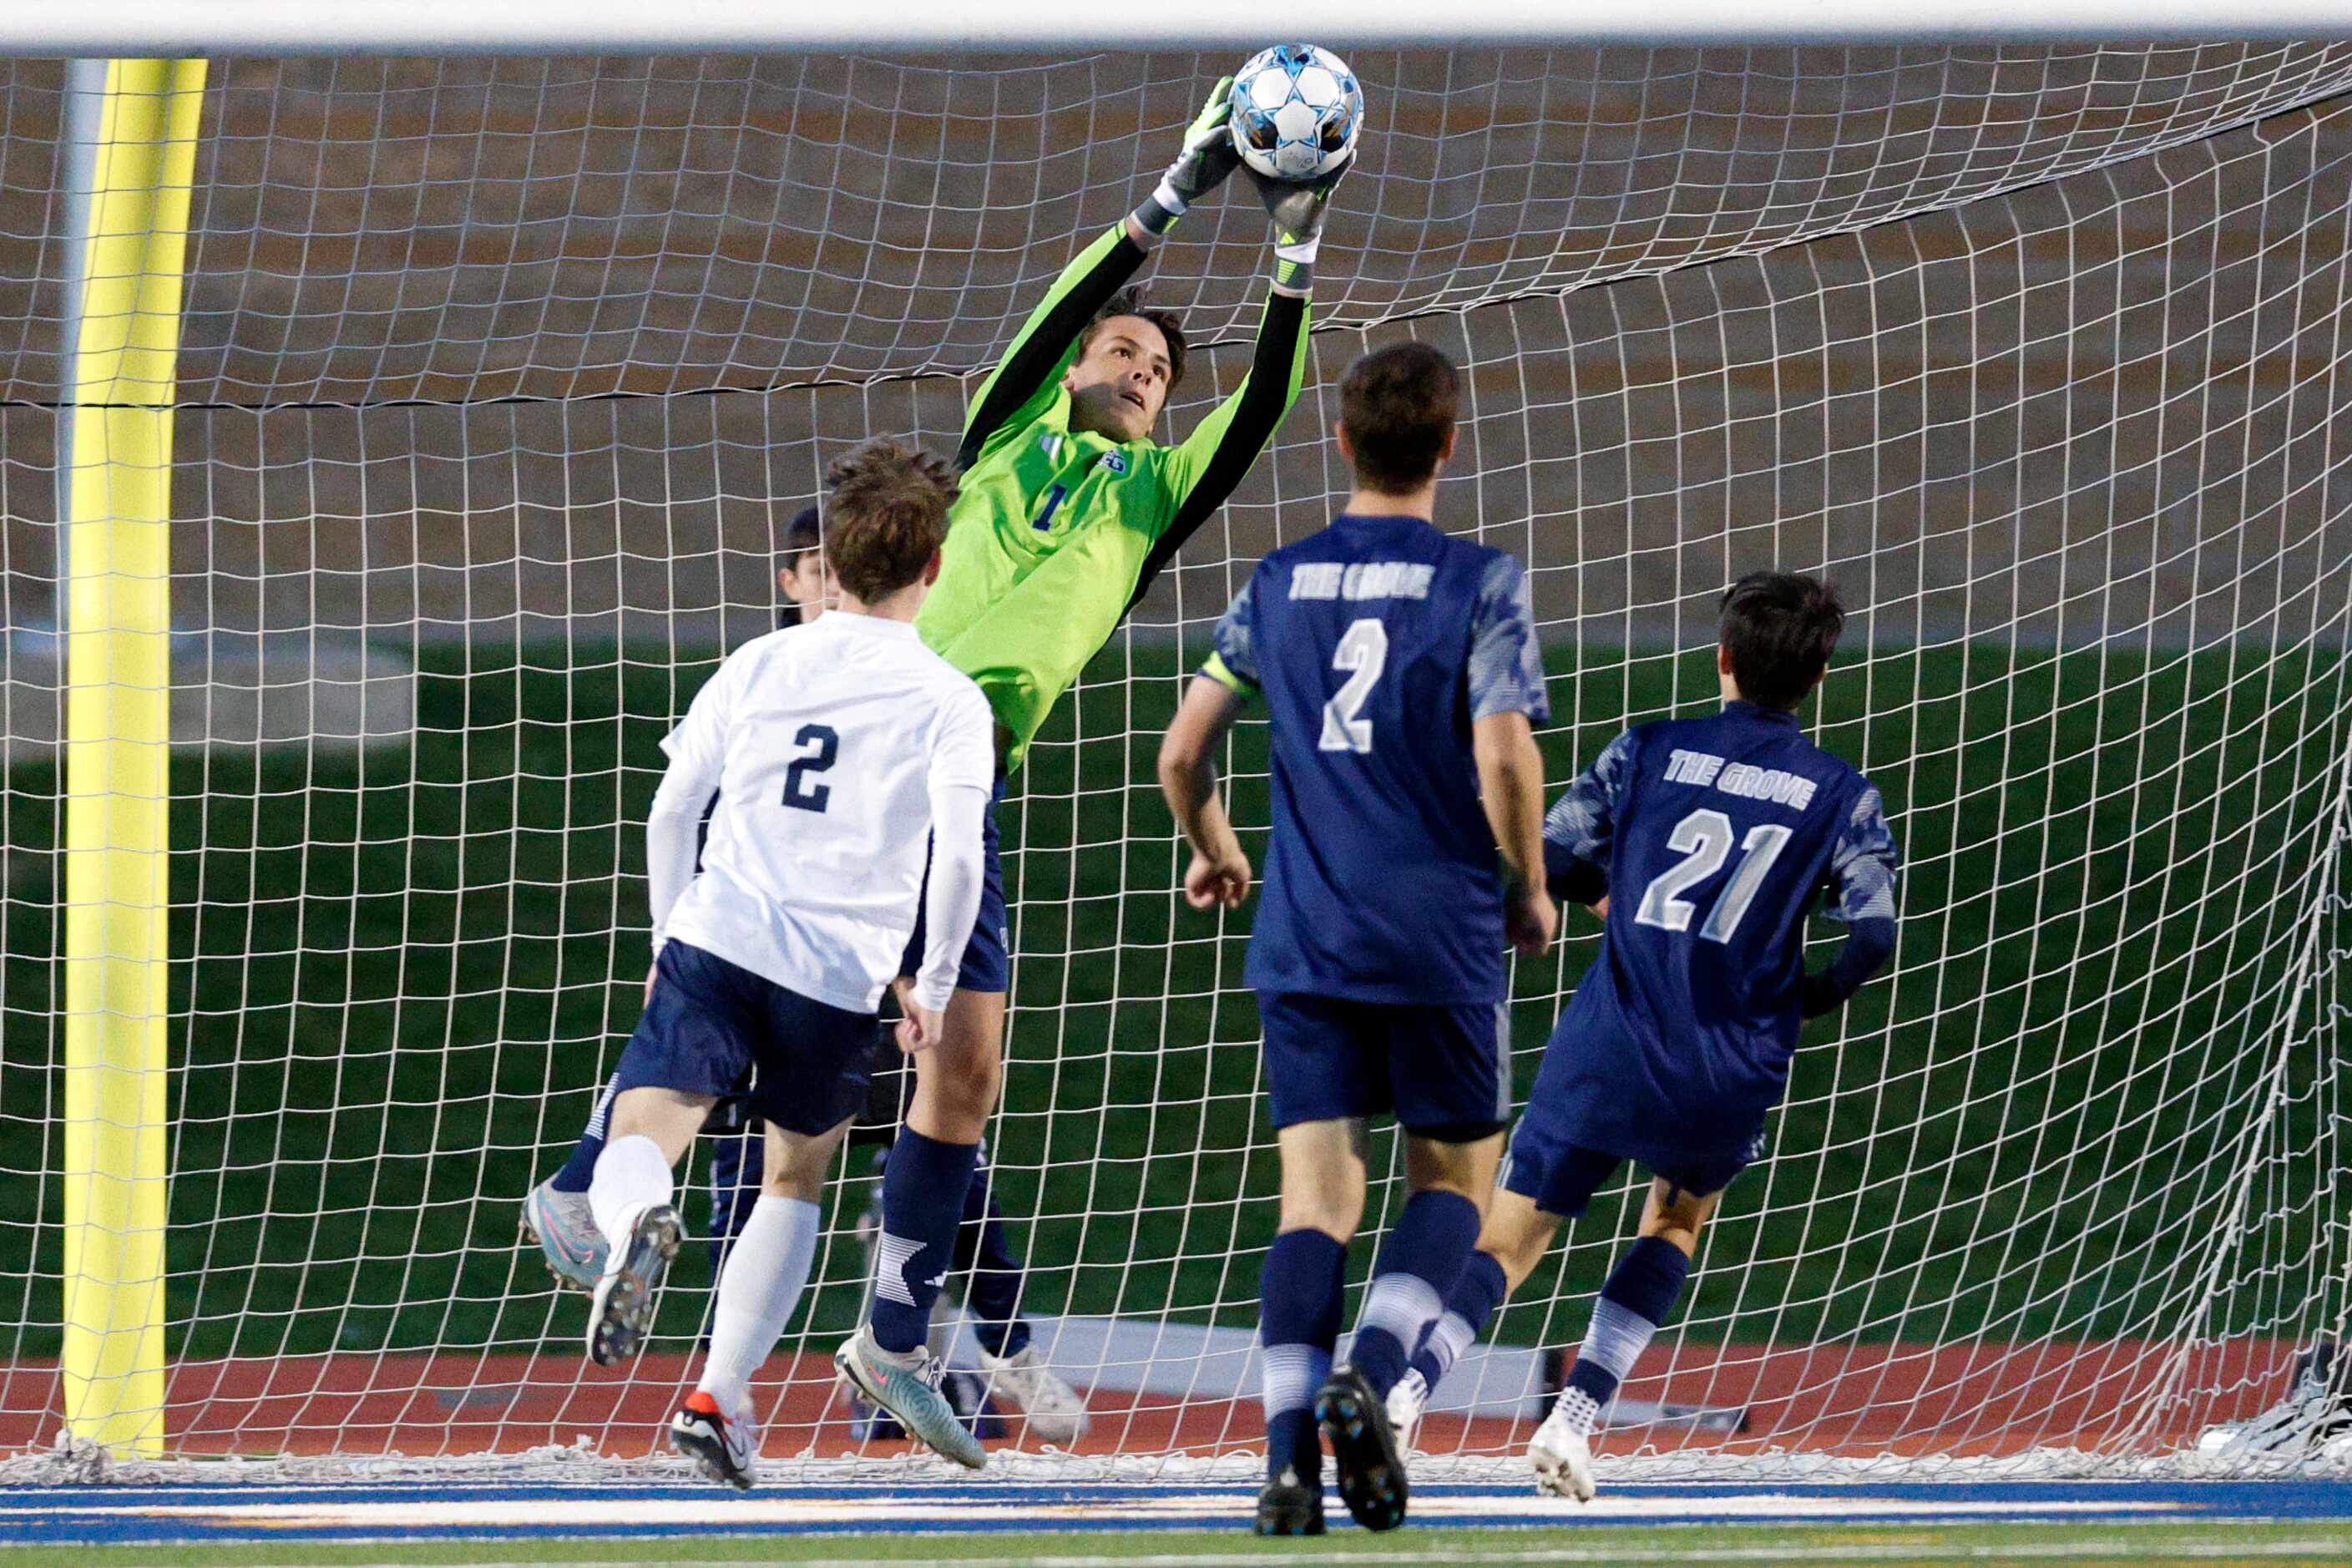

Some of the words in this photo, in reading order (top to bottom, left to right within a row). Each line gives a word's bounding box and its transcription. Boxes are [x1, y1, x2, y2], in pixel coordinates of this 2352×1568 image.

[1032, 483, 1066, 531] 1
[1318, 618, 1388, 754] 2
[781, 723, 839, 813] 2
[1663, 748, 1725, 787] THE
[1717, 761, 1818, 812] GROVE
[1634, 807, 1794, 945] 21
